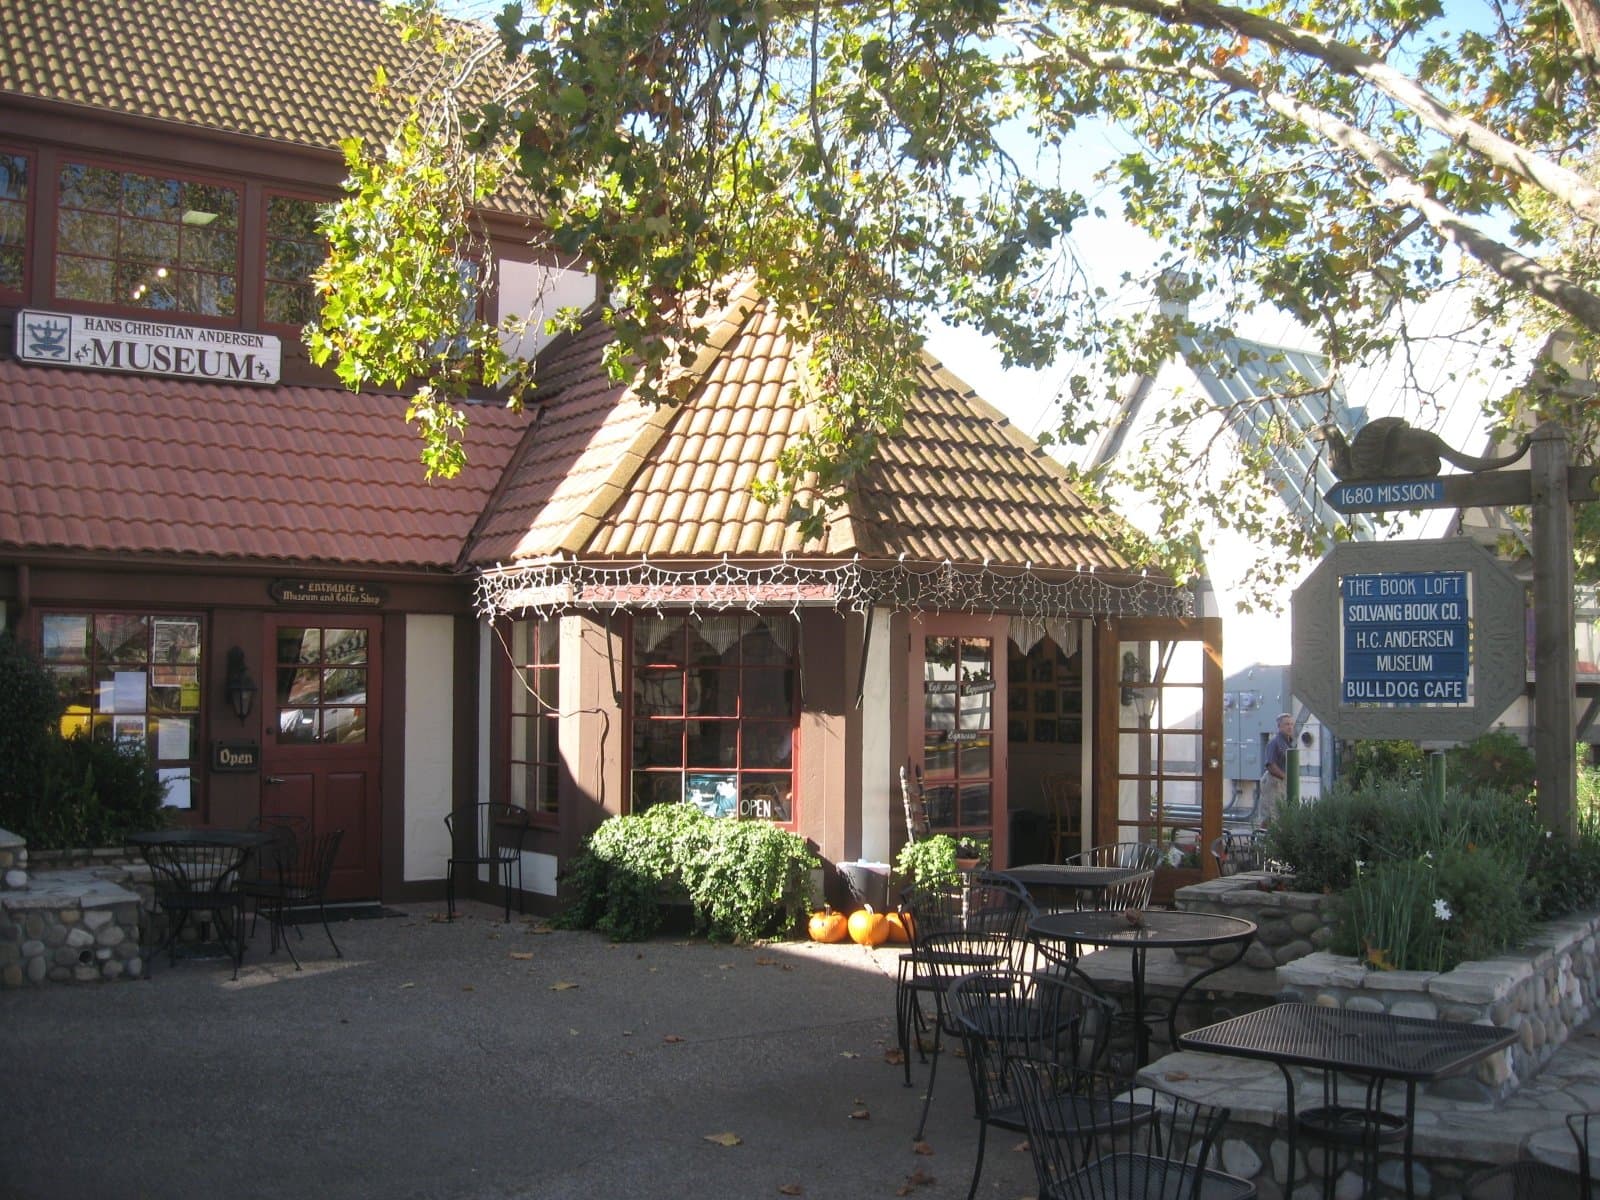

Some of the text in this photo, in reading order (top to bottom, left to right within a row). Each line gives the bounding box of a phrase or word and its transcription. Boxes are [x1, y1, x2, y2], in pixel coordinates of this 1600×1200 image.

[84, 317, 264, 348] HANS CHRISTIAN ANDERSEN
[90, 338, 256, 381] MUSEUM
[1341, 483, 1436, 504] 1680 MISSION
[1347, 577, 1461, 596] THE BOOK LOFT
[283, 591, 318, 601] Museum
[320, 592, 335, 602] and
[360, 592, 380, 605] Shop
[1349, 603, 1461, 622] SOLVANG BOOK CO.
[1384, 630, 1454, 648] ANDERSEN
[1376, 655, 1433, 672] MUSEUM
[1347, 681, 1462, 698] BULLDOG CAFE
[220, 748, 253, 766] Open
[740, 799, 771, 818] OPEN
